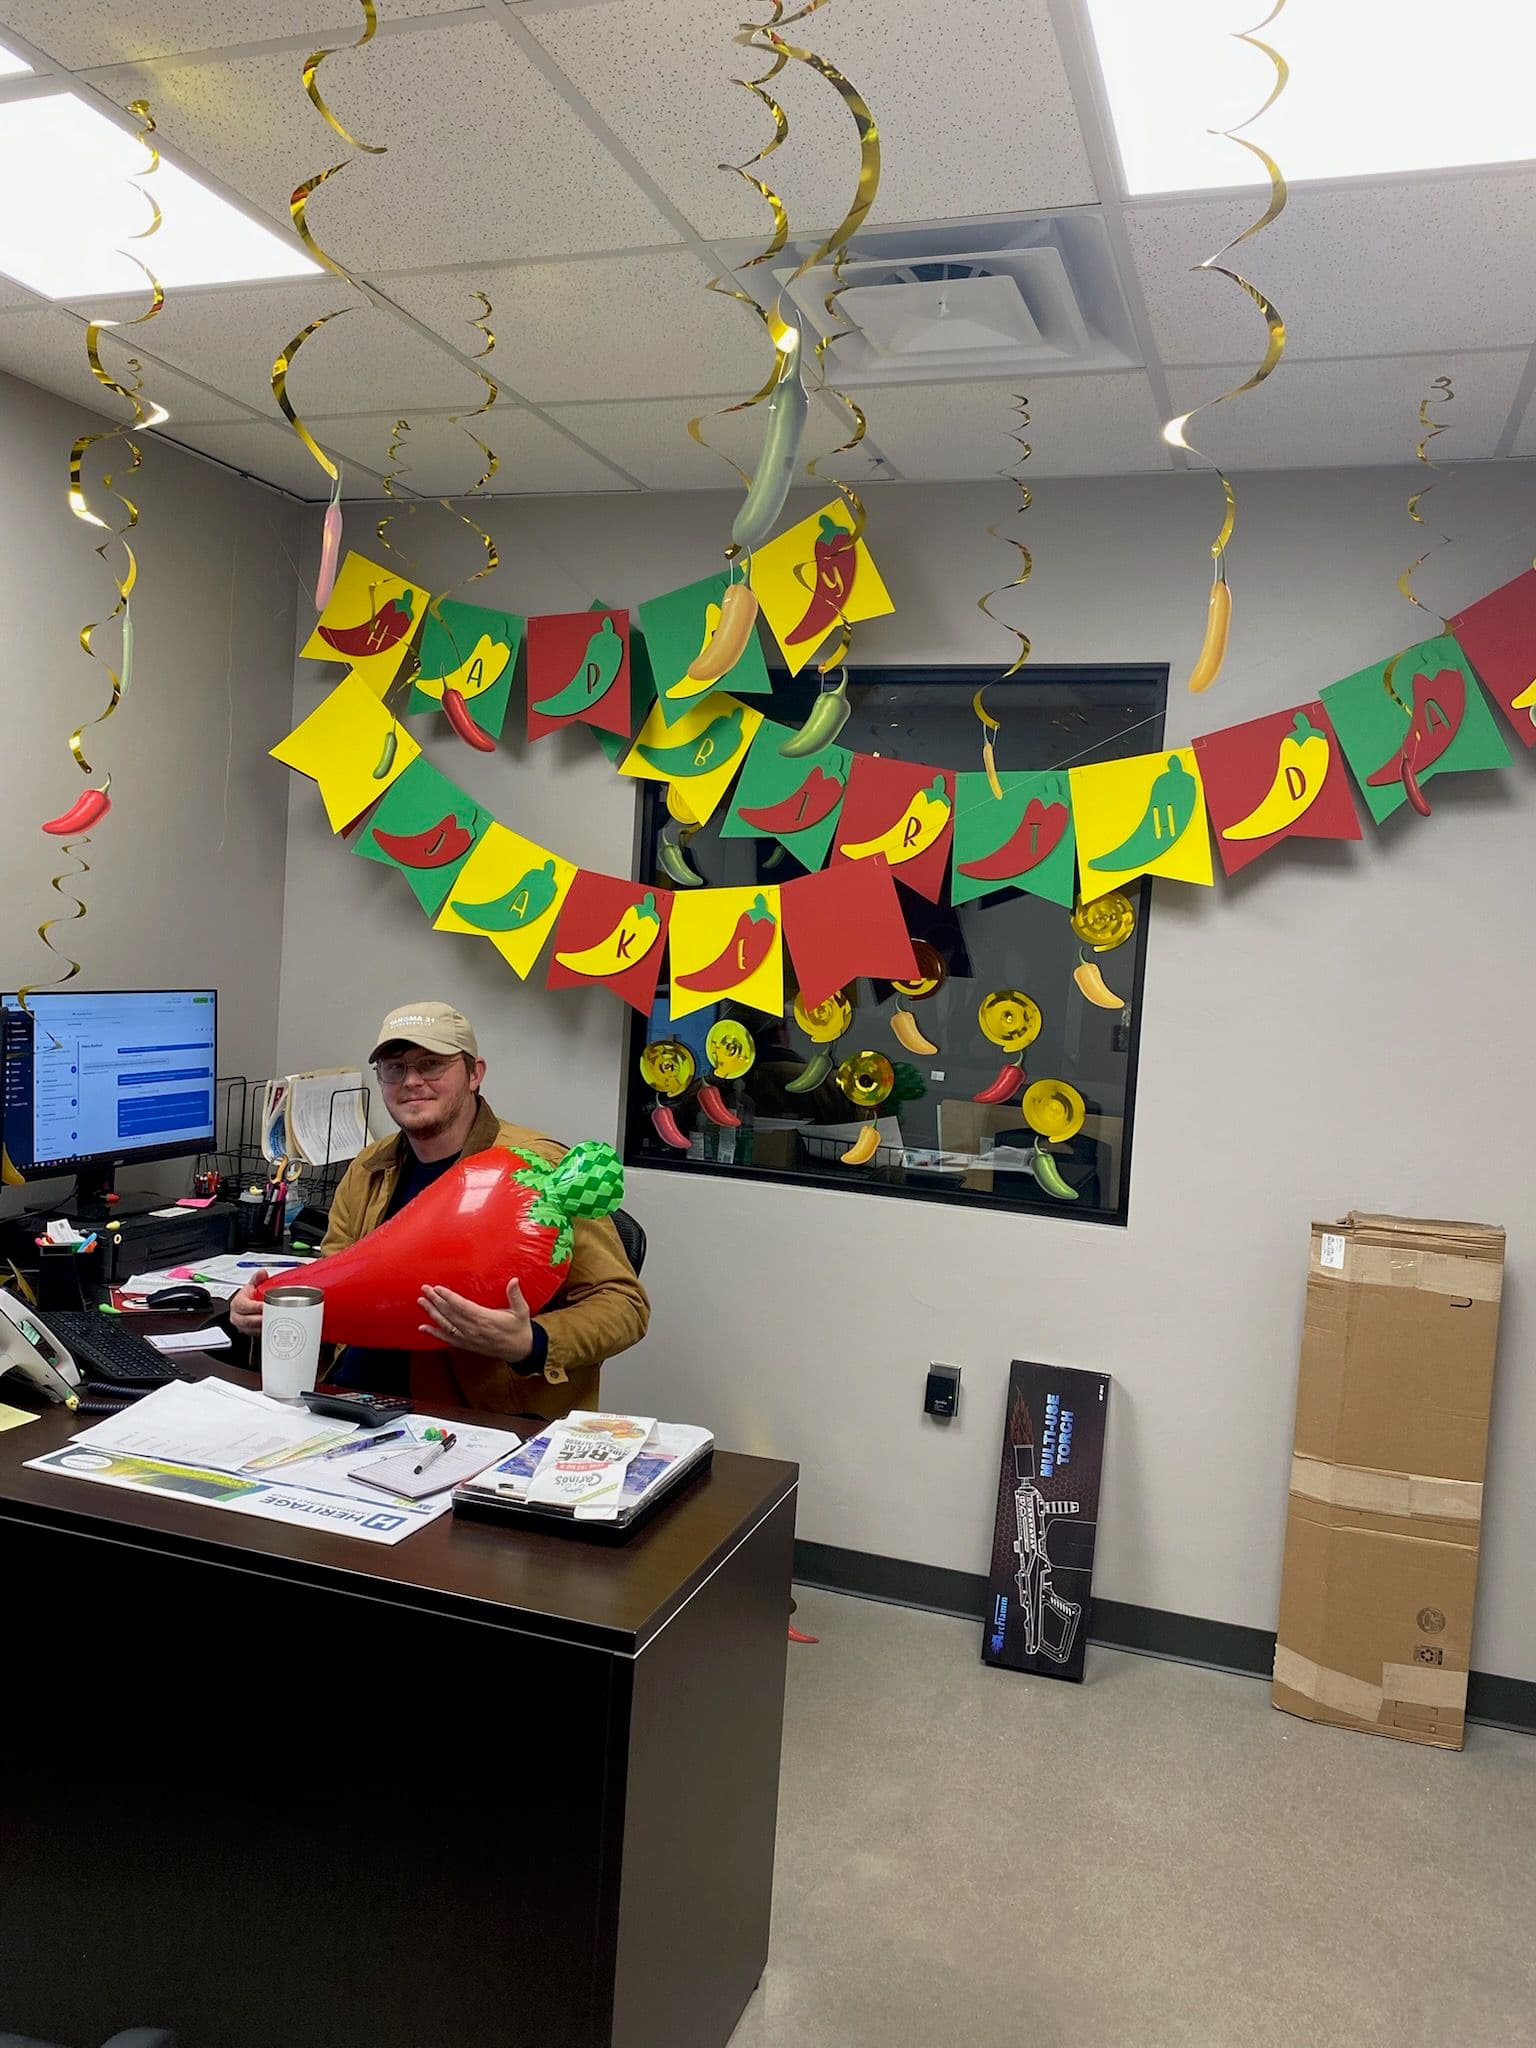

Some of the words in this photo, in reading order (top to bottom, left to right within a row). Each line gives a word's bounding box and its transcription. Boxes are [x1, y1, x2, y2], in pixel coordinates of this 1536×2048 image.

[1040, 1393, 1060, 1478] MULTI-USE
[1056, 1410, 1073, 1466] TORCH
[258, 1496, 366, 1523] HERITAGE
